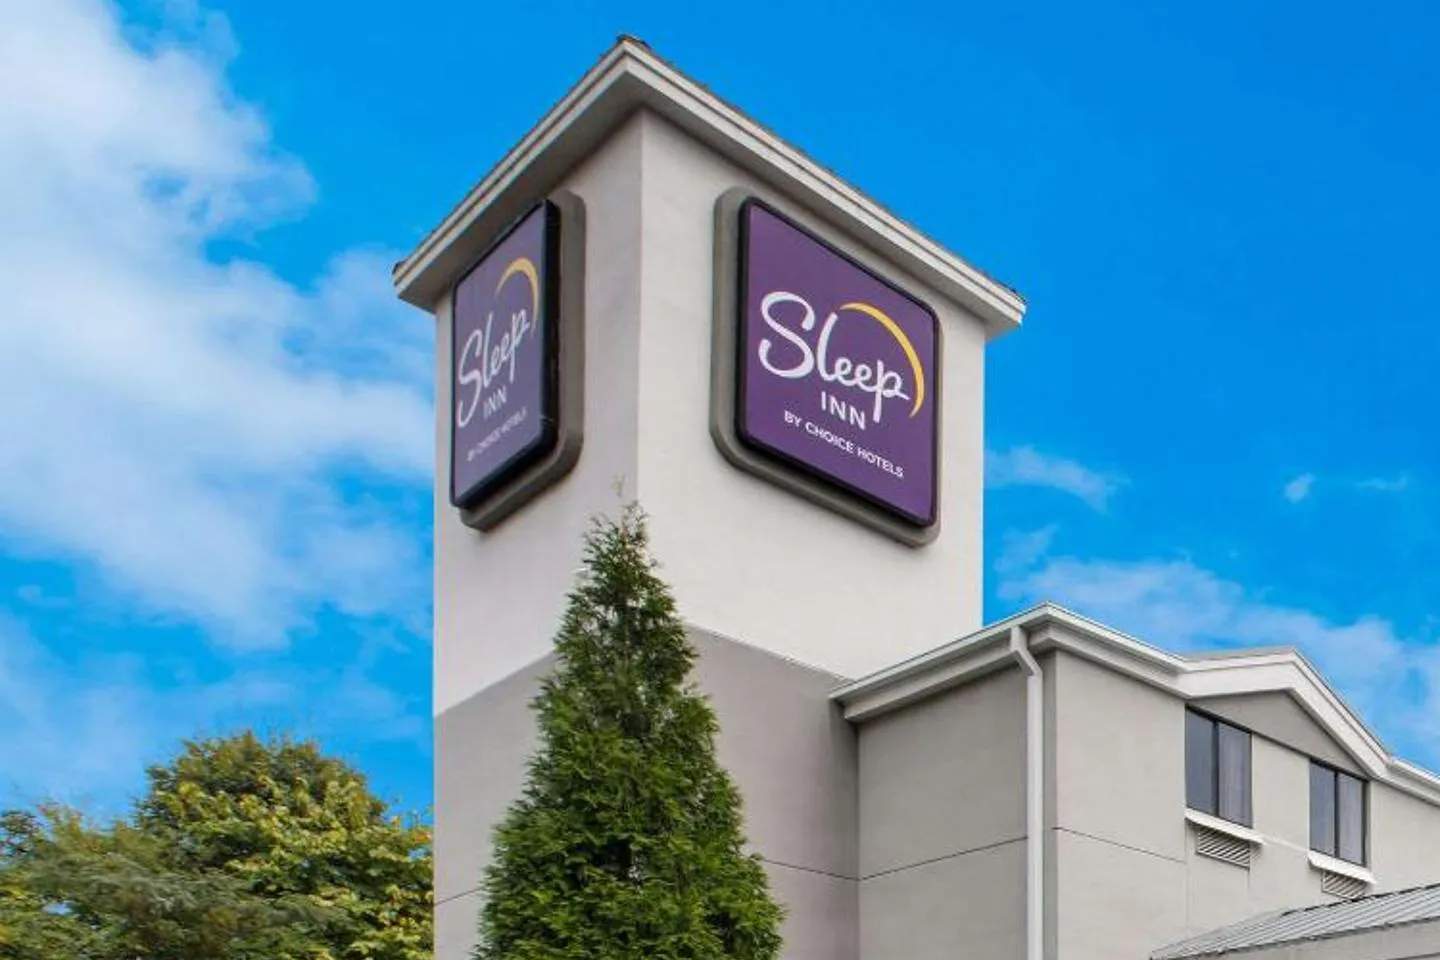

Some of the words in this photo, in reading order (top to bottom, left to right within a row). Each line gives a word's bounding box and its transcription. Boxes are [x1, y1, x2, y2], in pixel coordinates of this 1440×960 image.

[457, 309, 531, 428] Sleep
[758, 291, 910, 424] Sleep
[483, 384, 507, 420] INN
[821, 391, 866, 430] INN
[784, 410, 802, 427] BY
[805, 421, 854, 453] CHOICE
[857, 446, 904, 478] HOTELS
